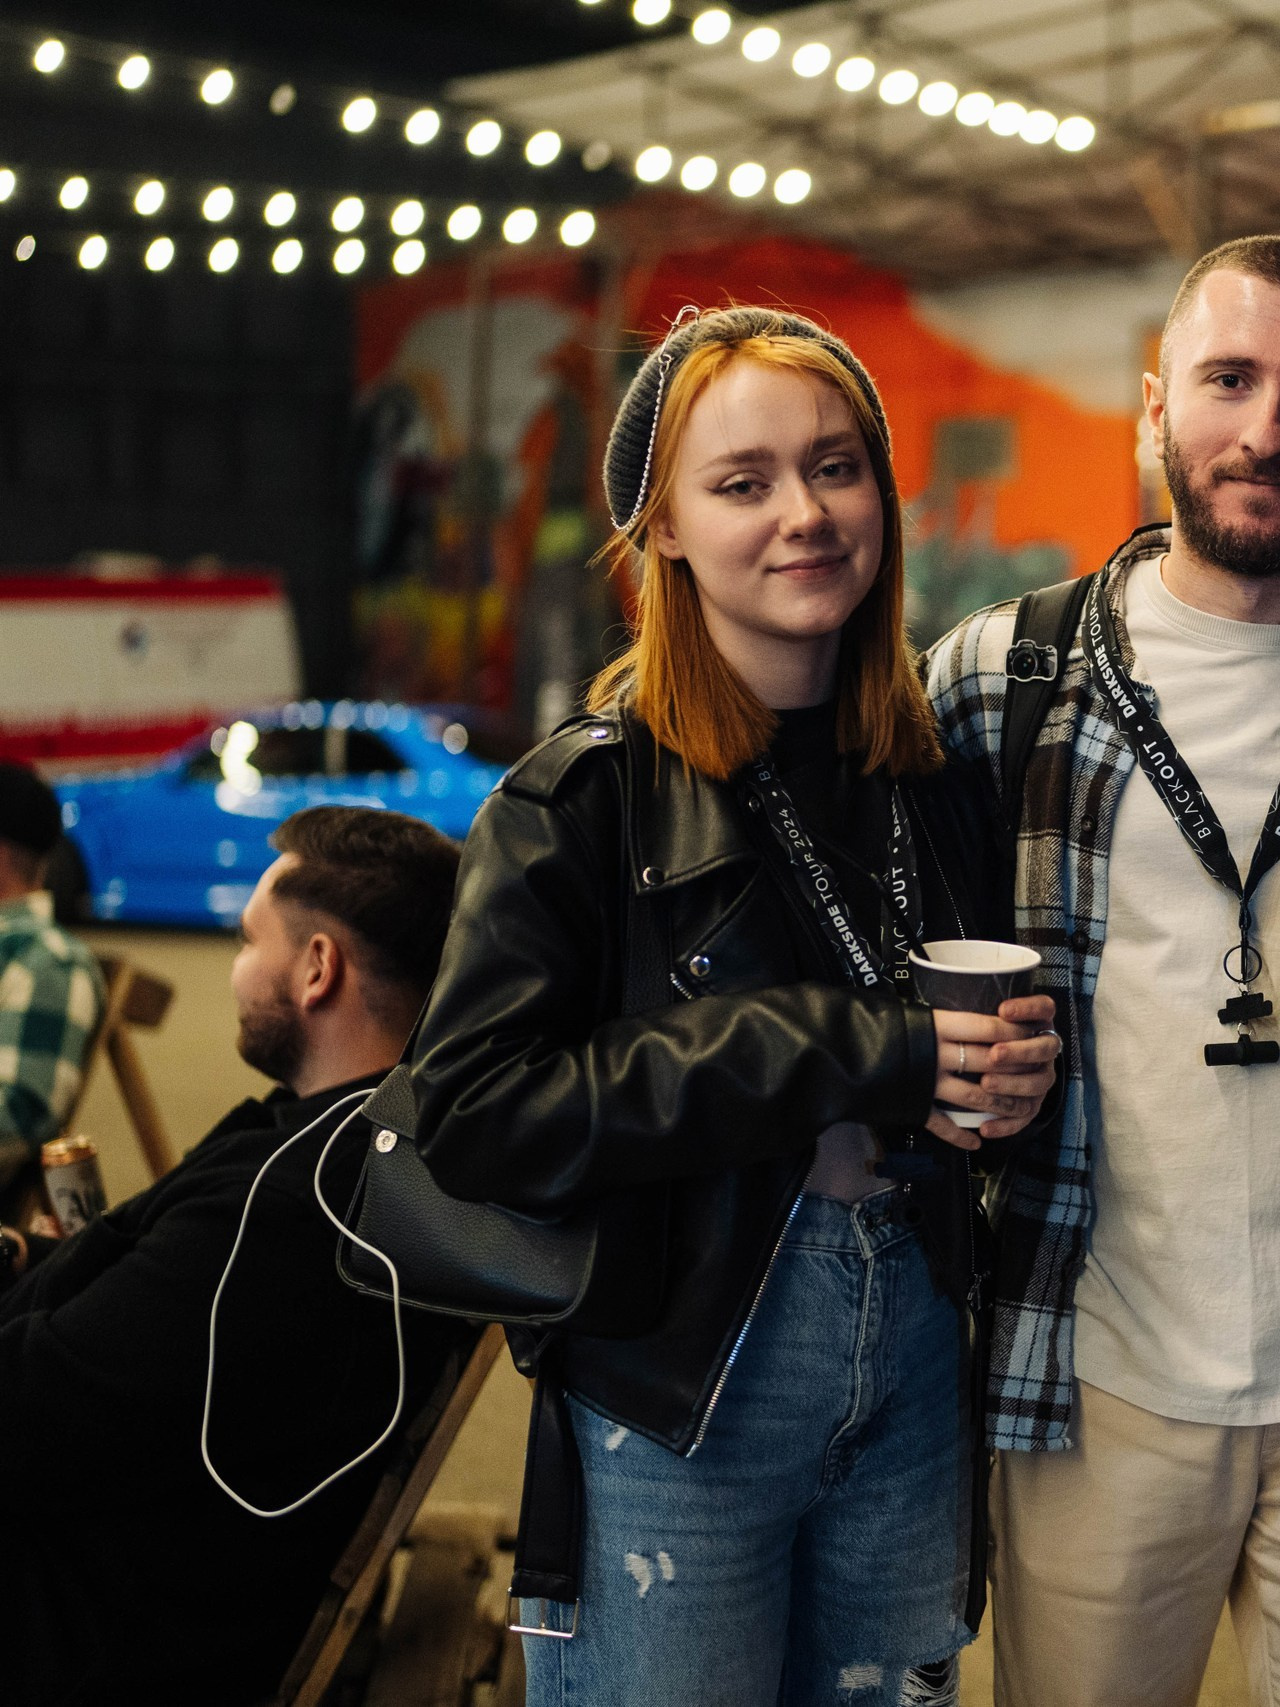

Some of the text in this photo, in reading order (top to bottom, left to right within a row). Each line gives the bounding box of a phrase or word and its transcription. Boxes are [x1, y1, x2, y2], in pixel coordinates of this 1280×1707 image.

[1089, 602, 1103, 647] TOUR
[1094, 643, 1137, 719] DARKSIDE
[1142, 740, 1212, 839] BLACKOUT
[779, 808, 879, 987] DARKSIDE TOUR 2024
[891, 866, 910, 979] BLACOUT
